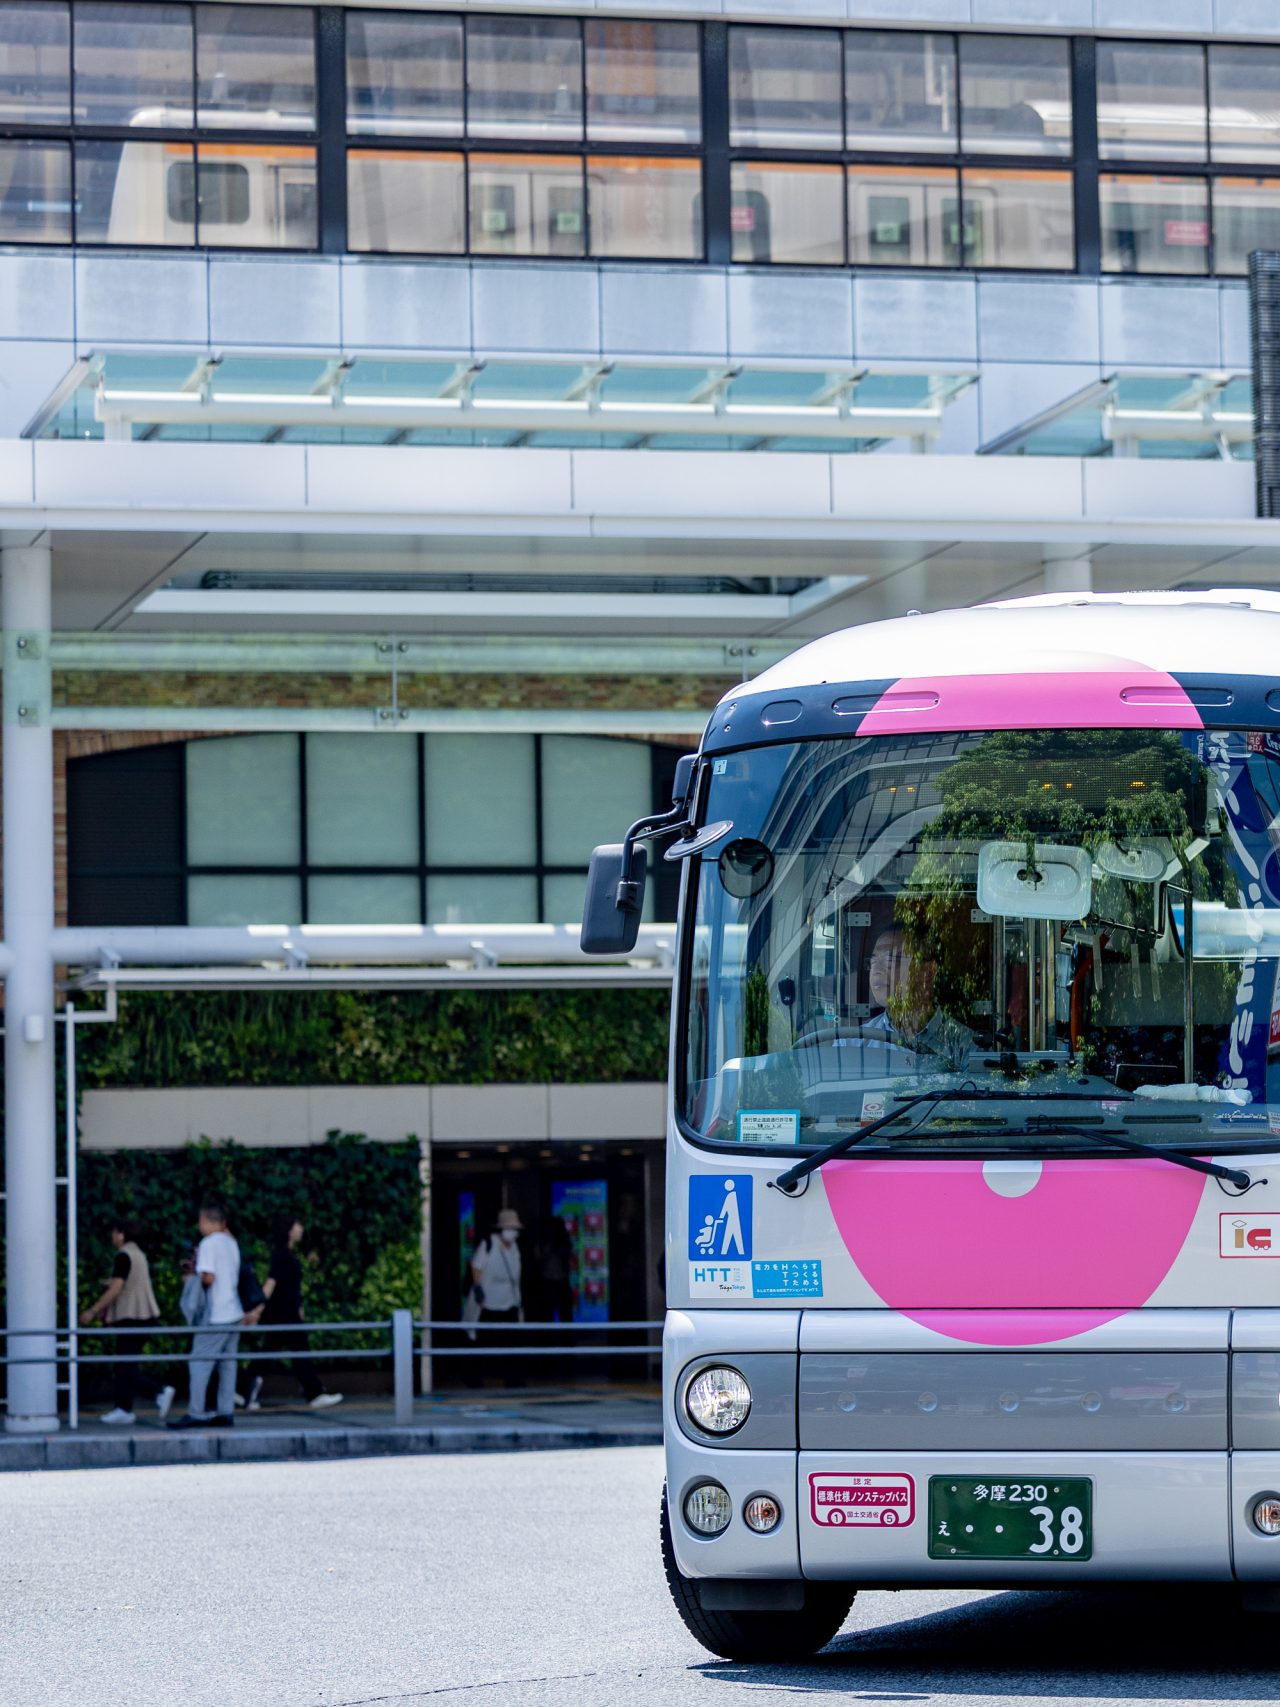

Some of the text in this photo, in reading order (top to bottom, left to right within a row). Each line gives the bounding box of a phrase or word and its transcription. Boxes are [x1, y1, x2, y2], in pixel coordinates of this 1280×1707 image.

[695, 1268, 731, 1281] HTT
[853, 1477, 872, 1486] 認定
[817, 1490, 908, 1503] 標準仕様ノンステップバス
[846, 1511, 879, 1519] 国土交通省
[938, 1505, 1084, 1554] え 38
